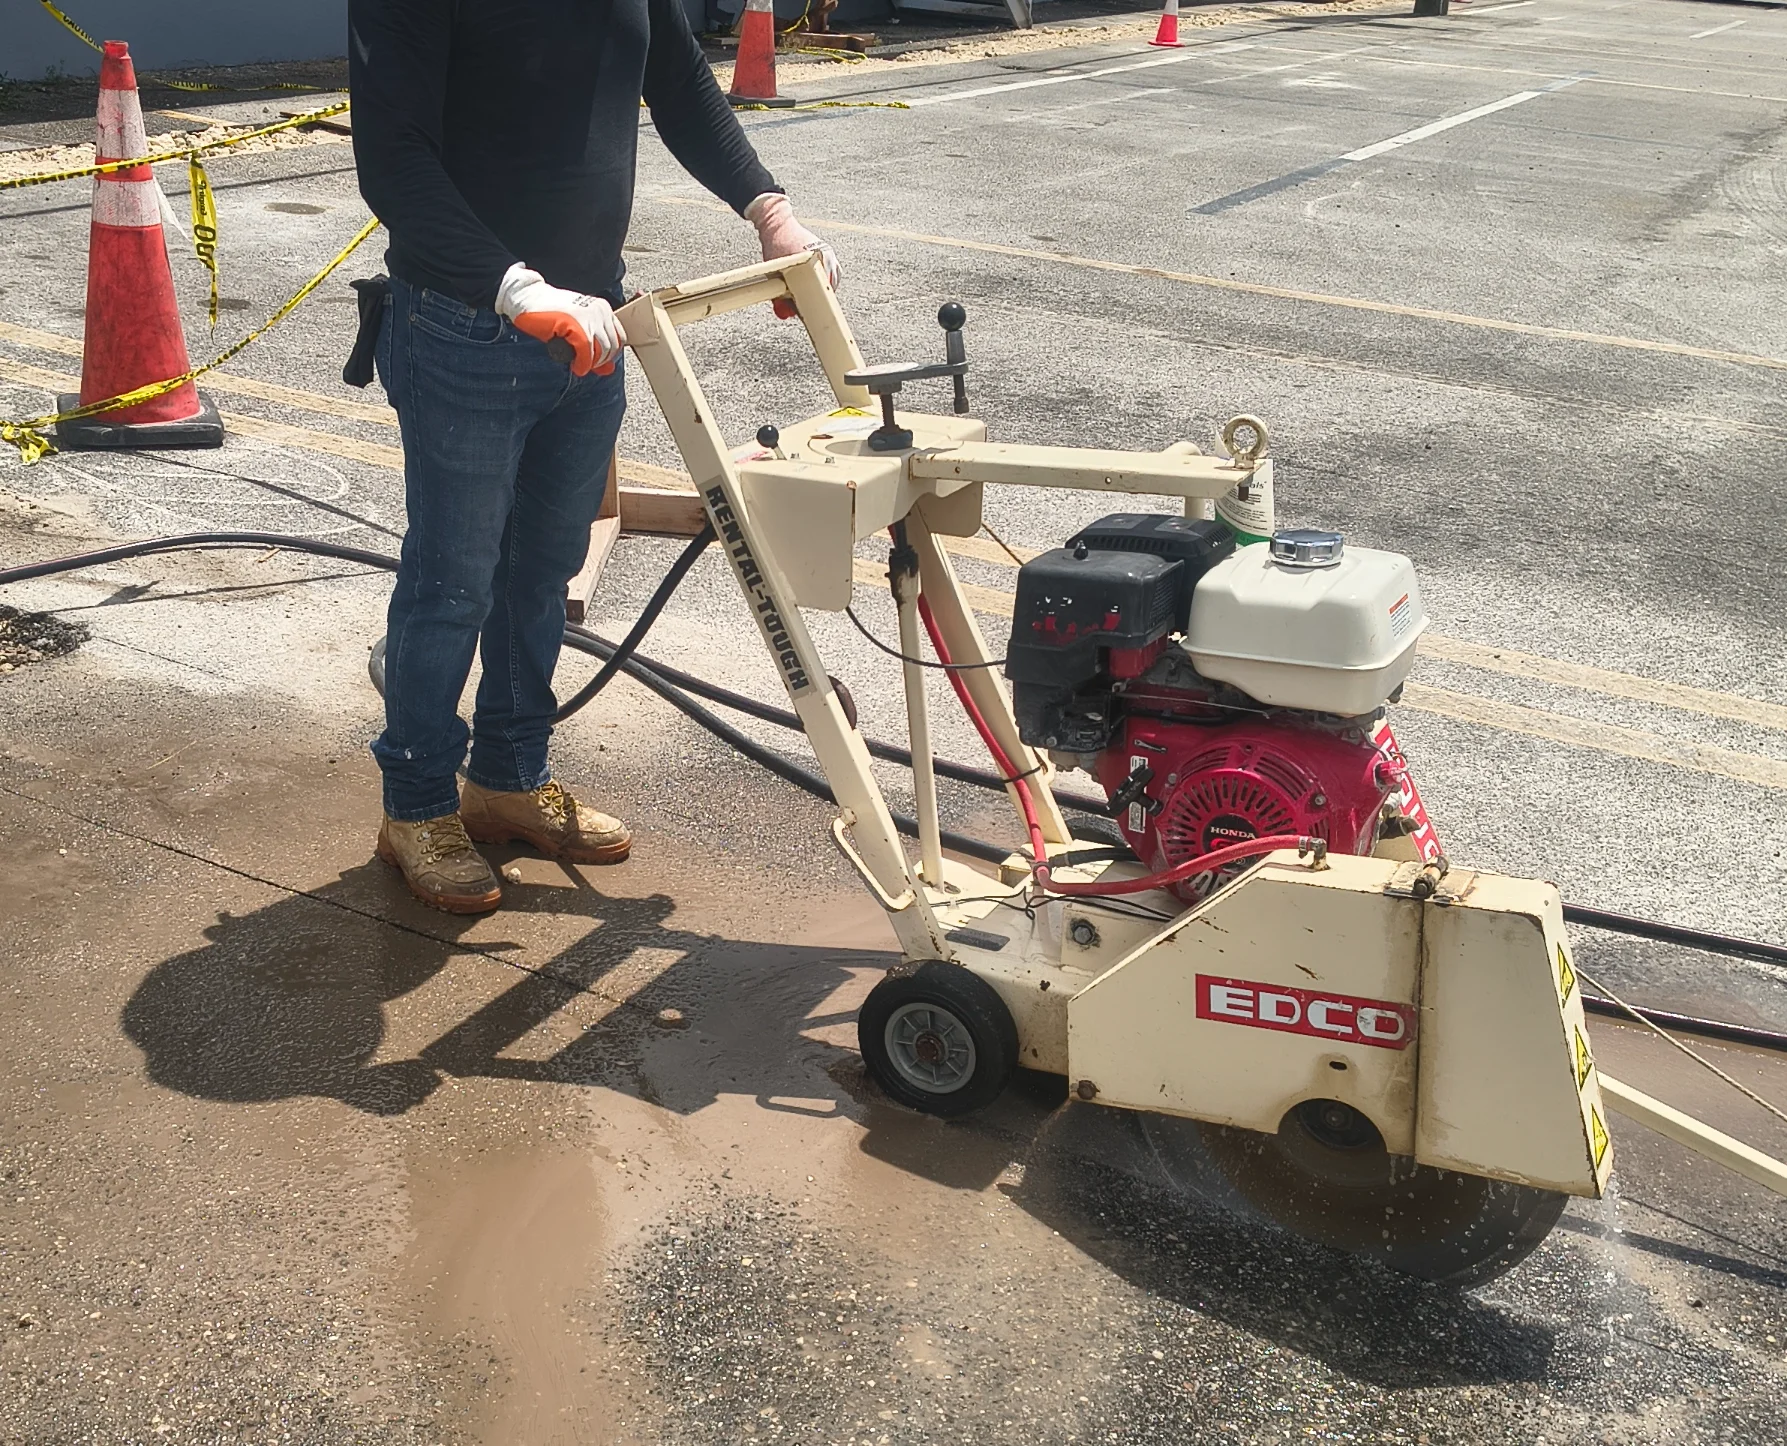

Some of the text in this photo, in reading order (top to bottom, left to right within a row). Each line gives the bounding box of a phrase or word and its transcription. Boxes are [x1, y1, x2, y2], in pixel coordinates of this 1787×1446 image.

[705, 484, 810, 691] RENTAL-TOUGH
[1210, 826, 1257, 840] HONDA
[1209, 984, 1405, 1041] EDCO
